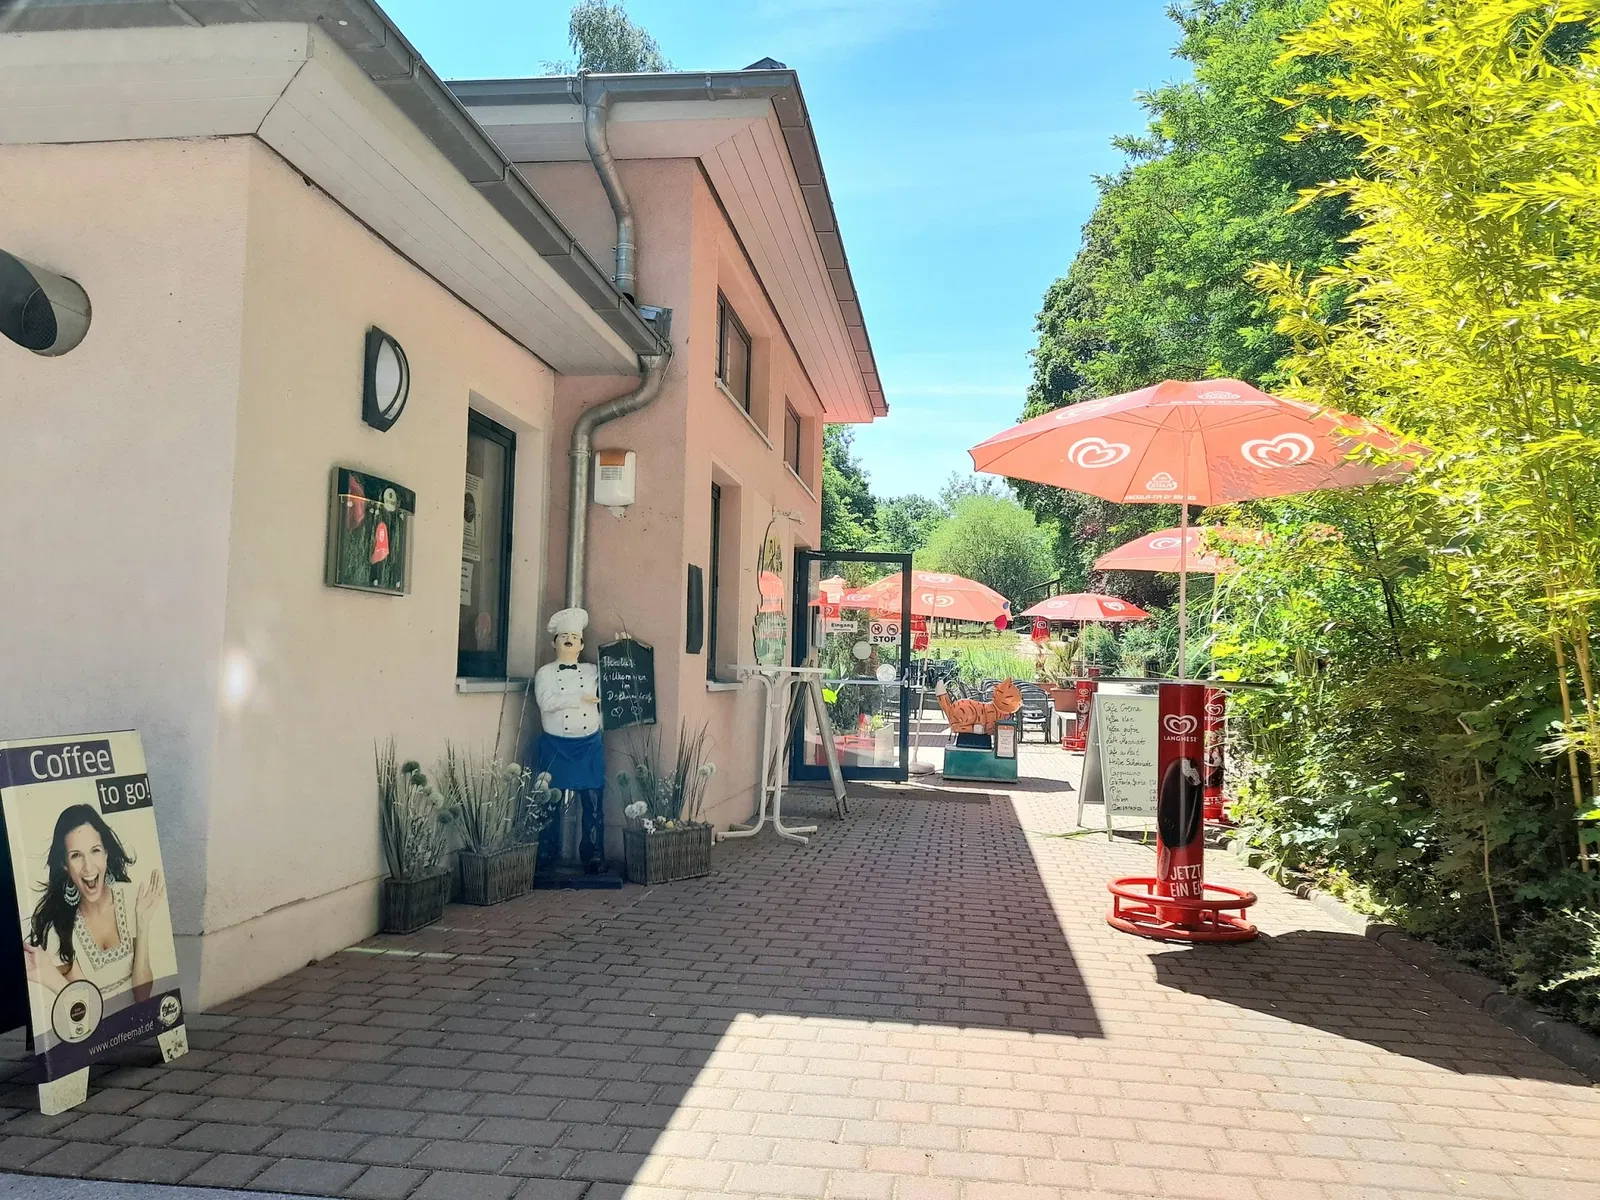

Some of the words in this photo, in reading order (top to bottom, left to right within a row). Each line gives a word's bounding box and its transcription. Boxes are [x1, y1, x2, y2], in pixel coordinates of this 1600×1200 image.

[873, 635, 896, 643] STOP
[1163, 735, 1198, 743] LANGNESE
[29, 745, 112, 780] Coffee
[100, 783, 120, 805] to
[124, 778, 151, 806] go!
[1170, 863, 1202, 881] JETZT
